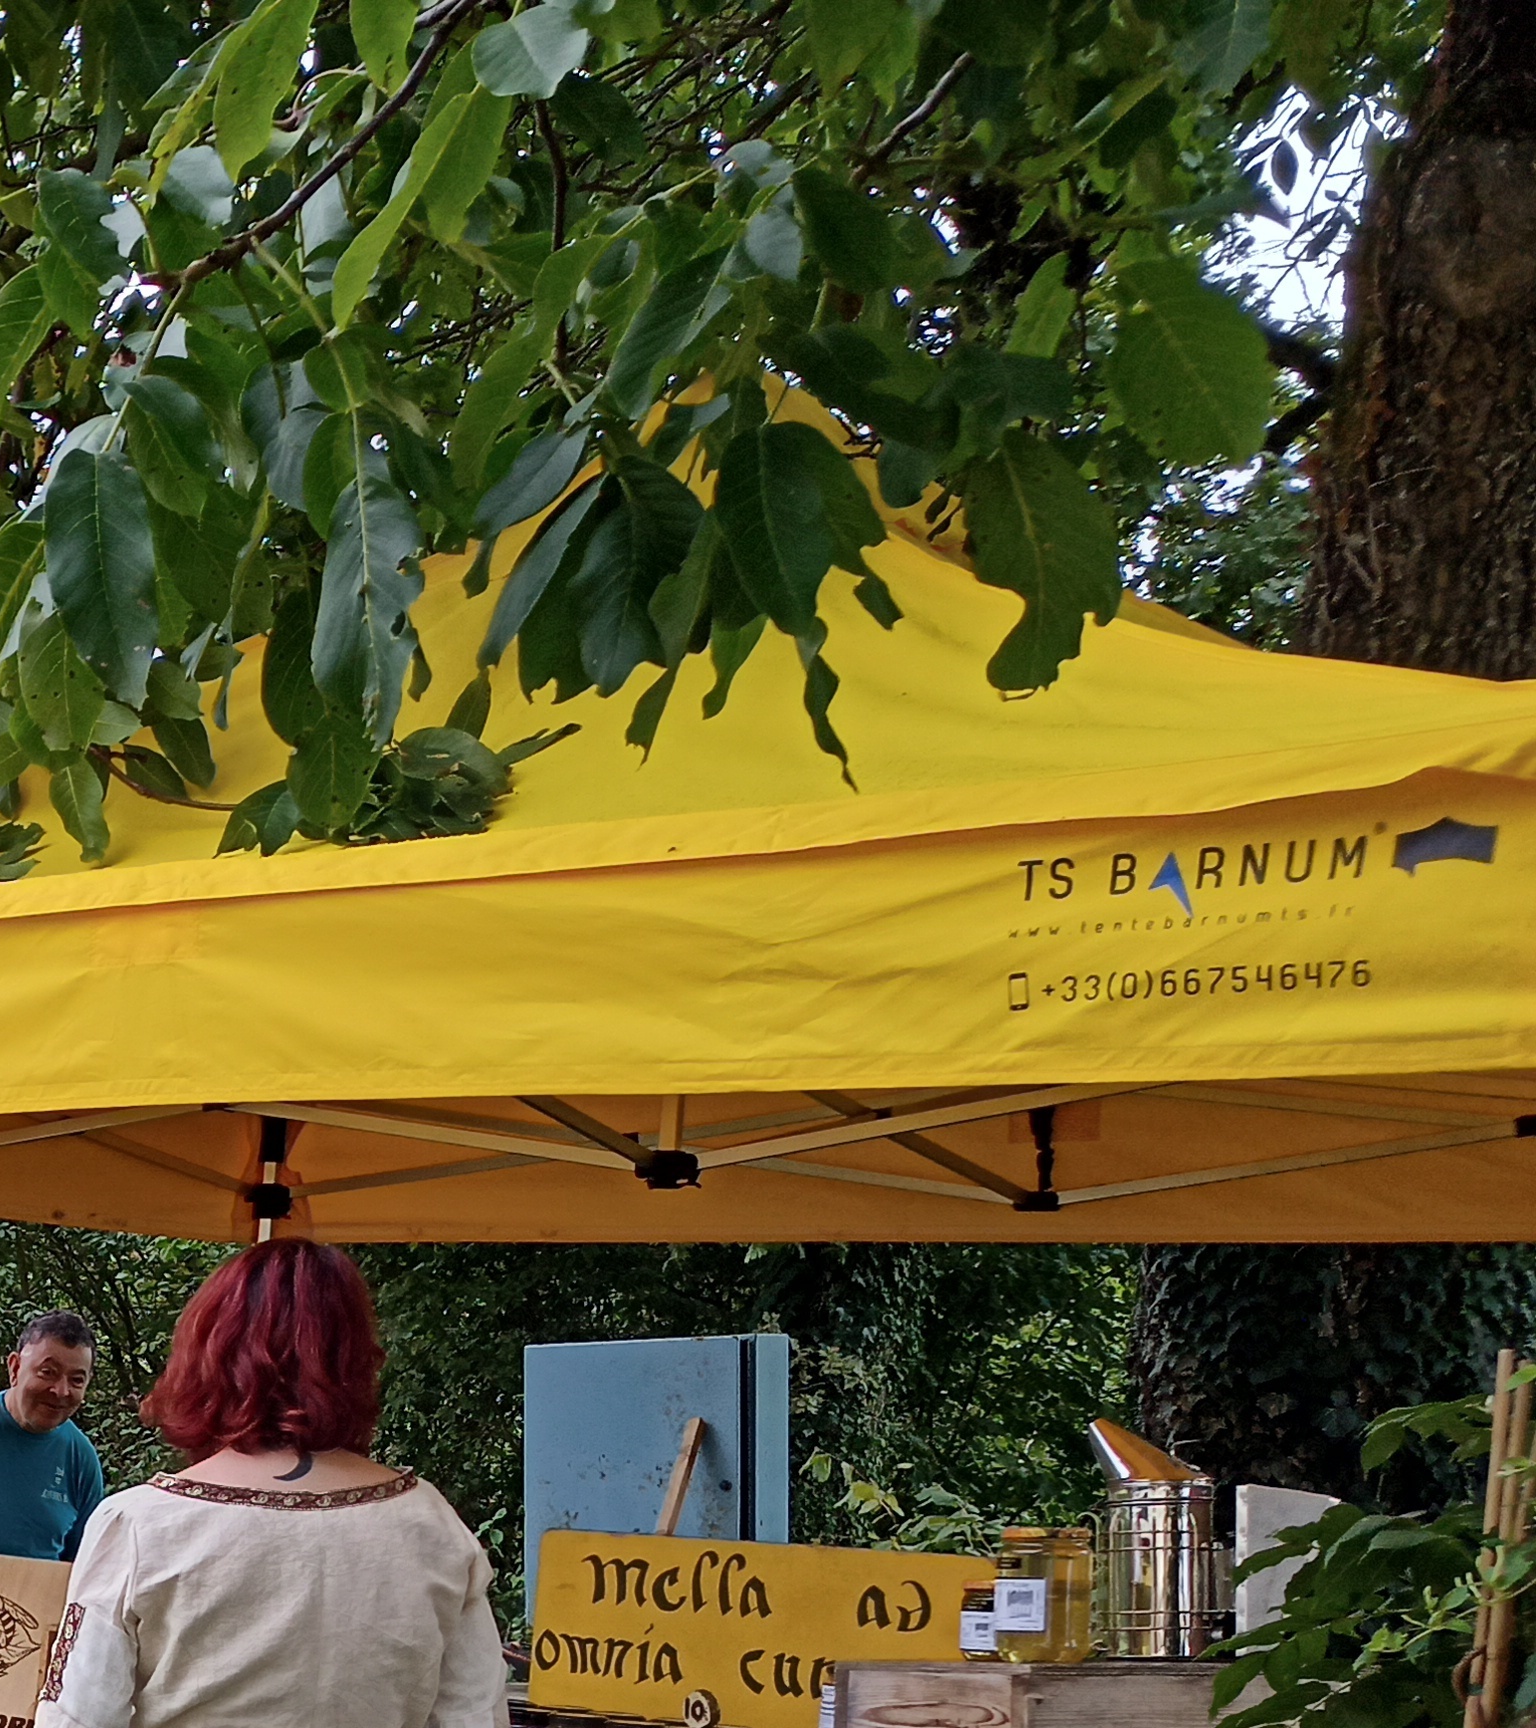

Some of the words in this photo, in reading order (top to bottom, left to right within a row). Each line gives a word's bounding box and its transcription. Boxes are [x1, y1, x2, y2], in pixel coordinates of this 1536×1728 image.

[1018, 857, 1075, 902] TS
[1109, 834, 1369, 918] BARNUM
[1041, 959, 1373, 1003] +33(0)667546476
[534, 1623, 684, 1685] omnia
